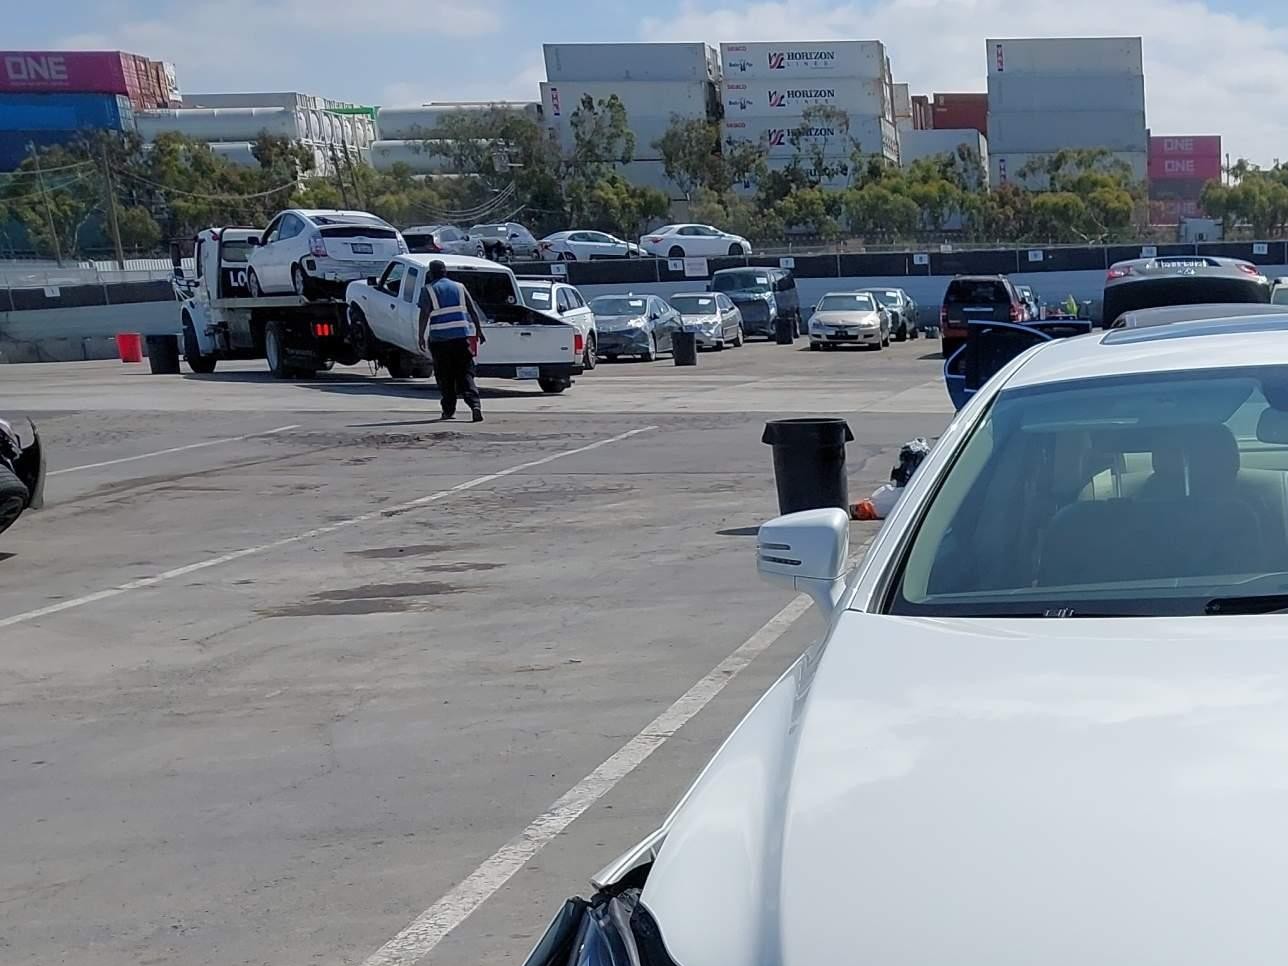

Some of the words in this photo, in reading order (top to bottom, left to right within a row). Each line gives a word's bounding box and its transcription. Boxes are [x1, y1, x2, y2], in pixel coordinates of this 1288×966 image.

[787, 51, 835, 60] HORIZON
[5, 56, 68, 79] ONE
[787, 89, 835, 98] HORIZON
[1165, 138, 1193, 151] ONE
[1165, 160, 1195, 172] ONE
